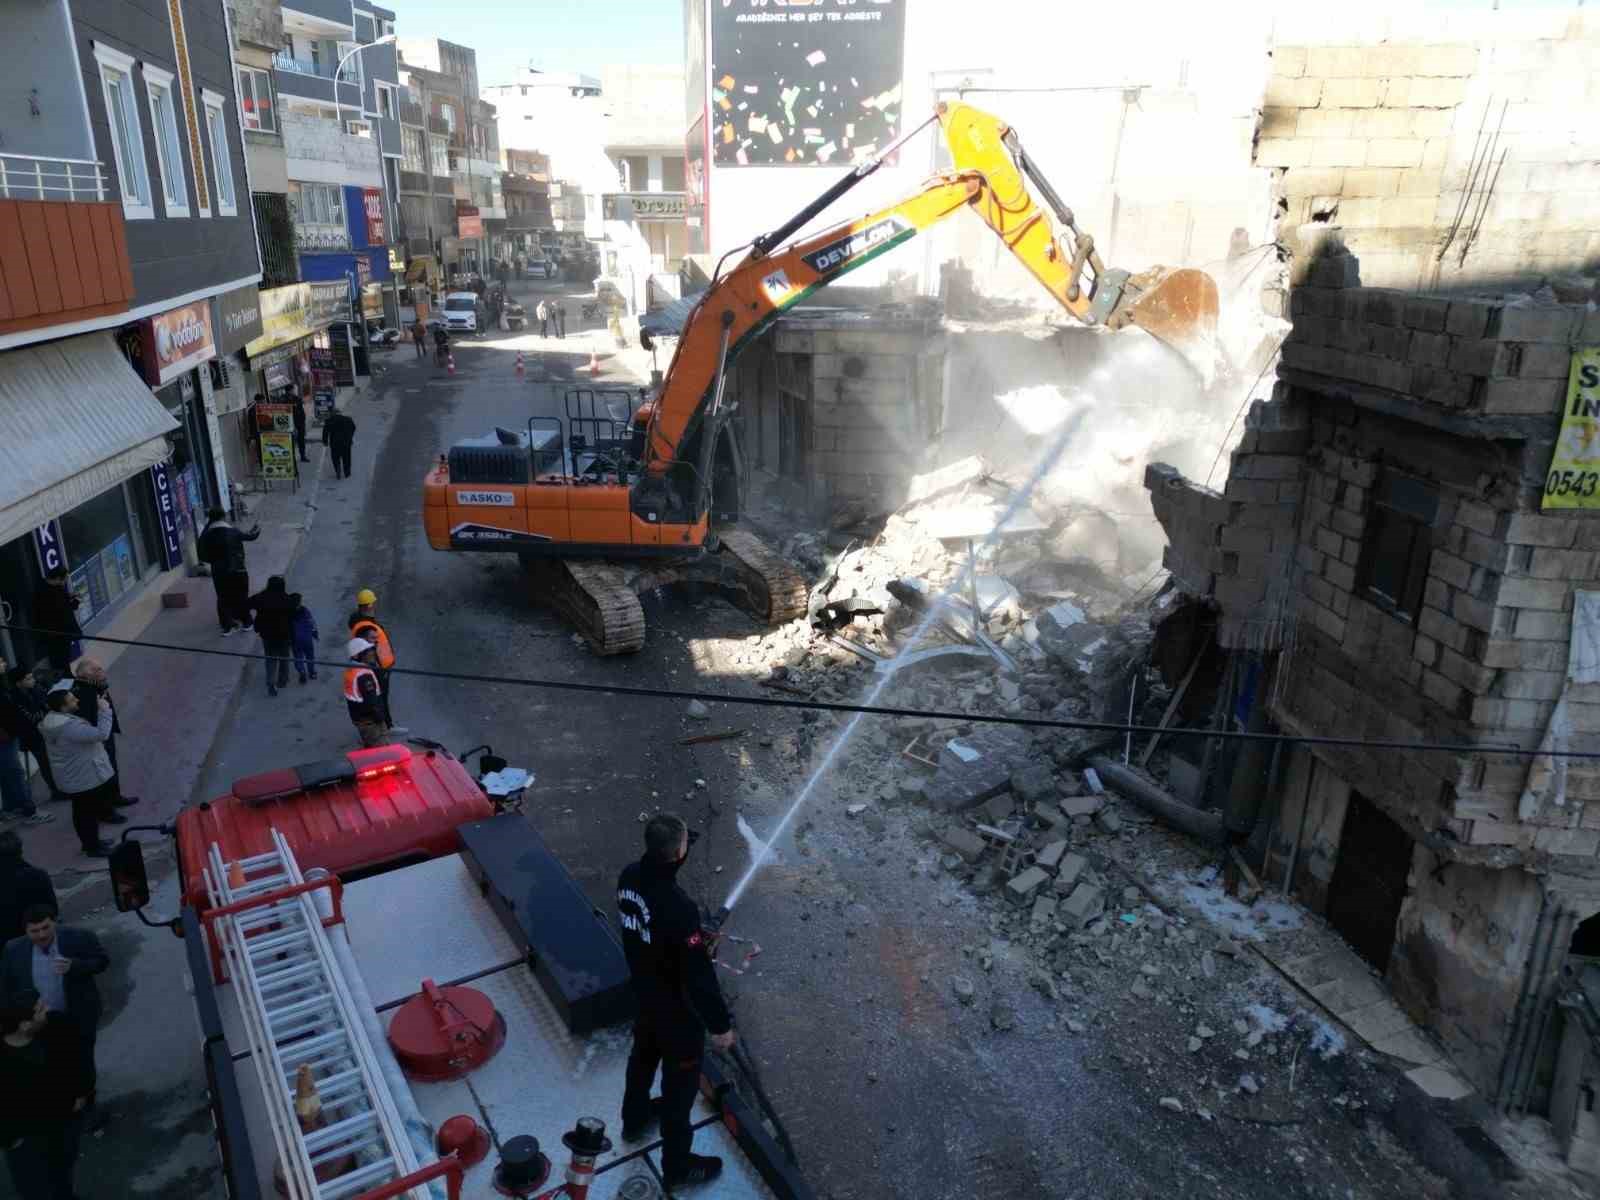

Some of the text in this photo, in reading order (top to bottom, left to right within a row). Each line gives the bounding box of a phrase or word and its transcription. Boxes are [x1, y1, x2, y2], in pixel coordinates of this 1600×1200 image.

[789, 13, 805, 21] HER
[826, 12, 841, 21] TEK
[815, 220, 896, 271] DEVON
[1546, 469, 1599, 497] 0543
